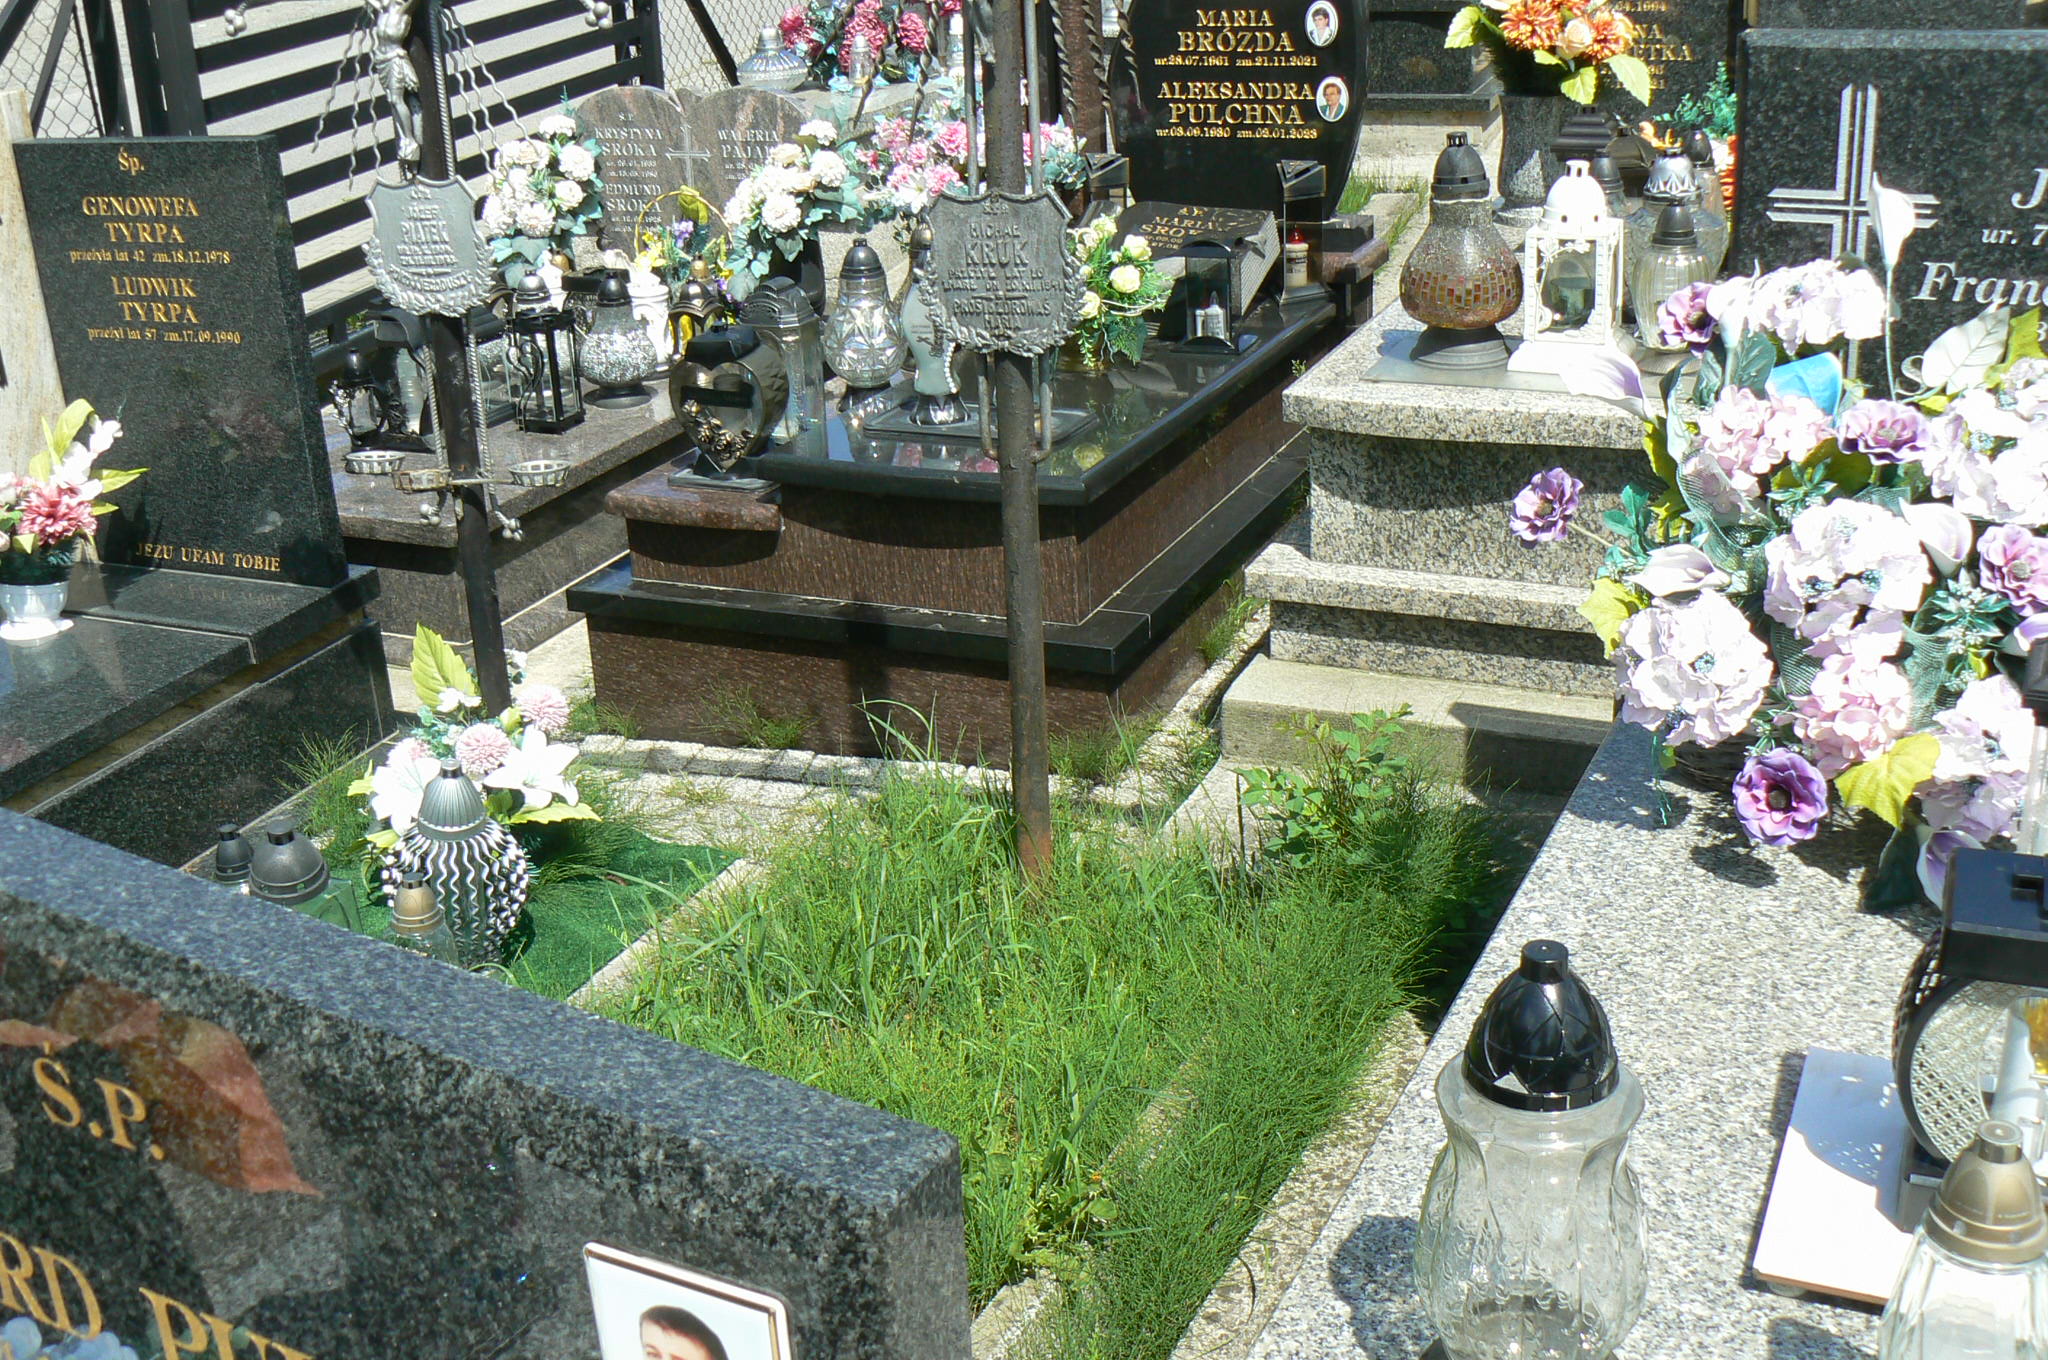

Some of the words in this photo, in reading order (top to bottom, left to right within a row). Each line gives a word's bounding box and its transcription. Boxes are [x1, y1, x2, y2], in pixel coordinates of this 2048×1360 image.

[1196, 9, 1274, 27] MARIA
[1177, 27, 1295, 53] BRÓZDA
[1157, 81, 1316, 101] ALEKSANDRA
[1168, 103, 1305, 125] PULCHNA
[594, 126, 663, 140] KRYSTYNA
[717, 129, 779, 142] WALERIA
[600, 142, 658, 157] SROKA
[604, 183, 662, 196] EDMUND
[81, 196, 200, 217] GENOWEFA
[605, 198, 663, 212] SROKA
[104, 221, 185, 244] TYRPA
[115, 249, 129, 262] lat
[133, 251, 146, 262] 42
[964, 240, 1030, 267] KRUK
[111, 275, 198, 298] LUDWIK
[1912, 261, 2048, 307] Fran
[118, 301, 200, 324] TYRPA
[127, 328, 141, 340] lat
[136, 543, 174, 560] JEZU
[181, 547, 225, 566] UFAM
[232, 552, 281, 572] TOBIE
[0, 1231, 103, 1340] RD
